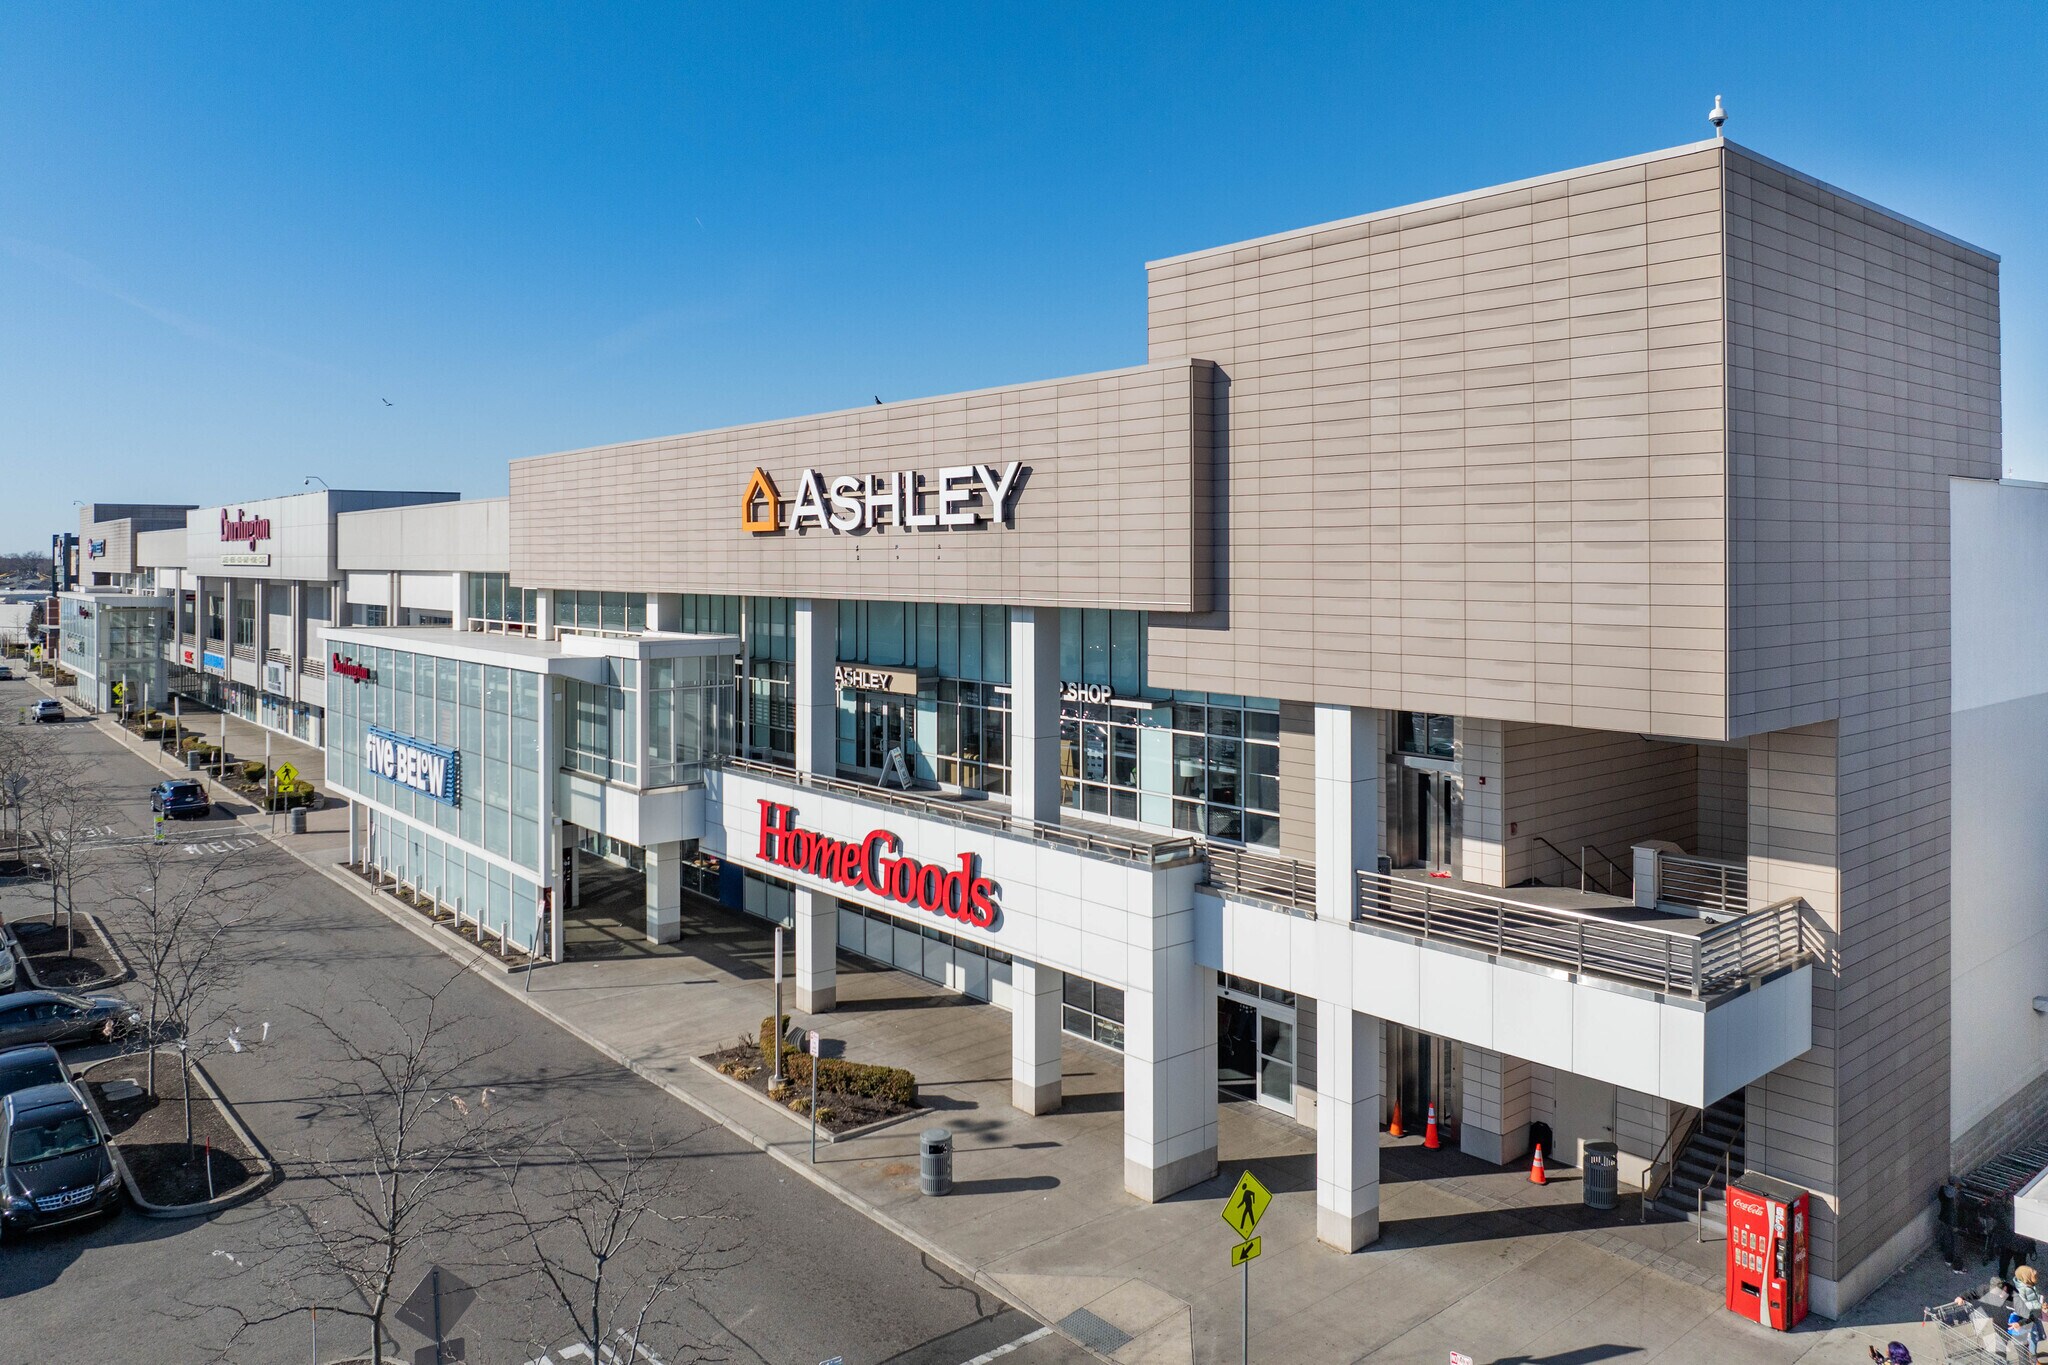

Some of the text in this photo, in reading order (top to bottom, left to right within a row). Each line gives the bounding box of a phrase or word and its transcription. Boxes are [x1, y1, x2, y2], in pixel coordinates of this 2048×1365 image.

[788, 461, 1022, 532] ASHLEY
[220, 508, 271, 552] Burlington
[332, 652, 371, 683] Burlington
[835, 666, 890, 690] ASHLEY
[1067, 681, 1113, 704] SHOP
[365, 733, 446, 797] five BELOW
[183, 838, 258, 855] YIELD
[755, 798, 996, 929] HomeGoods
[1732, 1198, 1765, 1217] Coca-Cola
